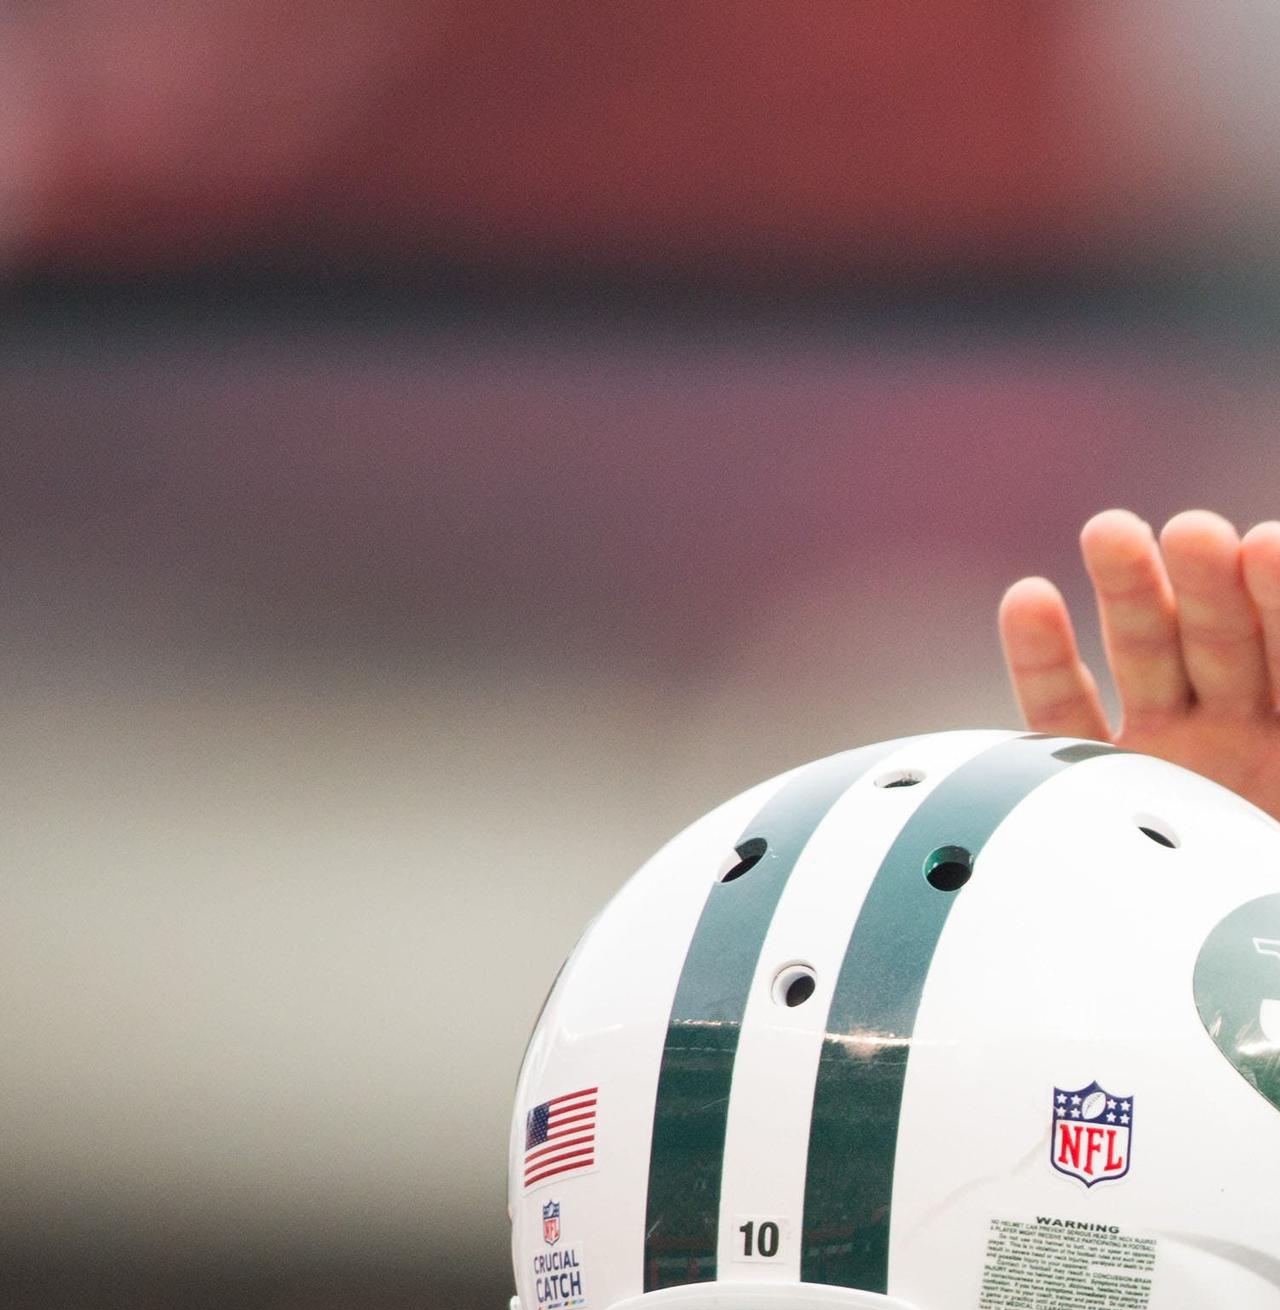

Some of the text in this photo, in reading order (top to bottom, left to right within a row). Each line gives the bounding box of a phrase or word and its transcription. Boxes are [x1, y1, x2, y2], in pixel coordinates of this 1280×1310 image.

[1058, 1124, 1122, 1176] NFL
[739, 1221, 780, 1258] 10
[1036, 1216, 1119, 1233] WARNING
[534, 1250, 580, 1275] CRUCIAL
[536, 1271, 582, 1304] CATCH
